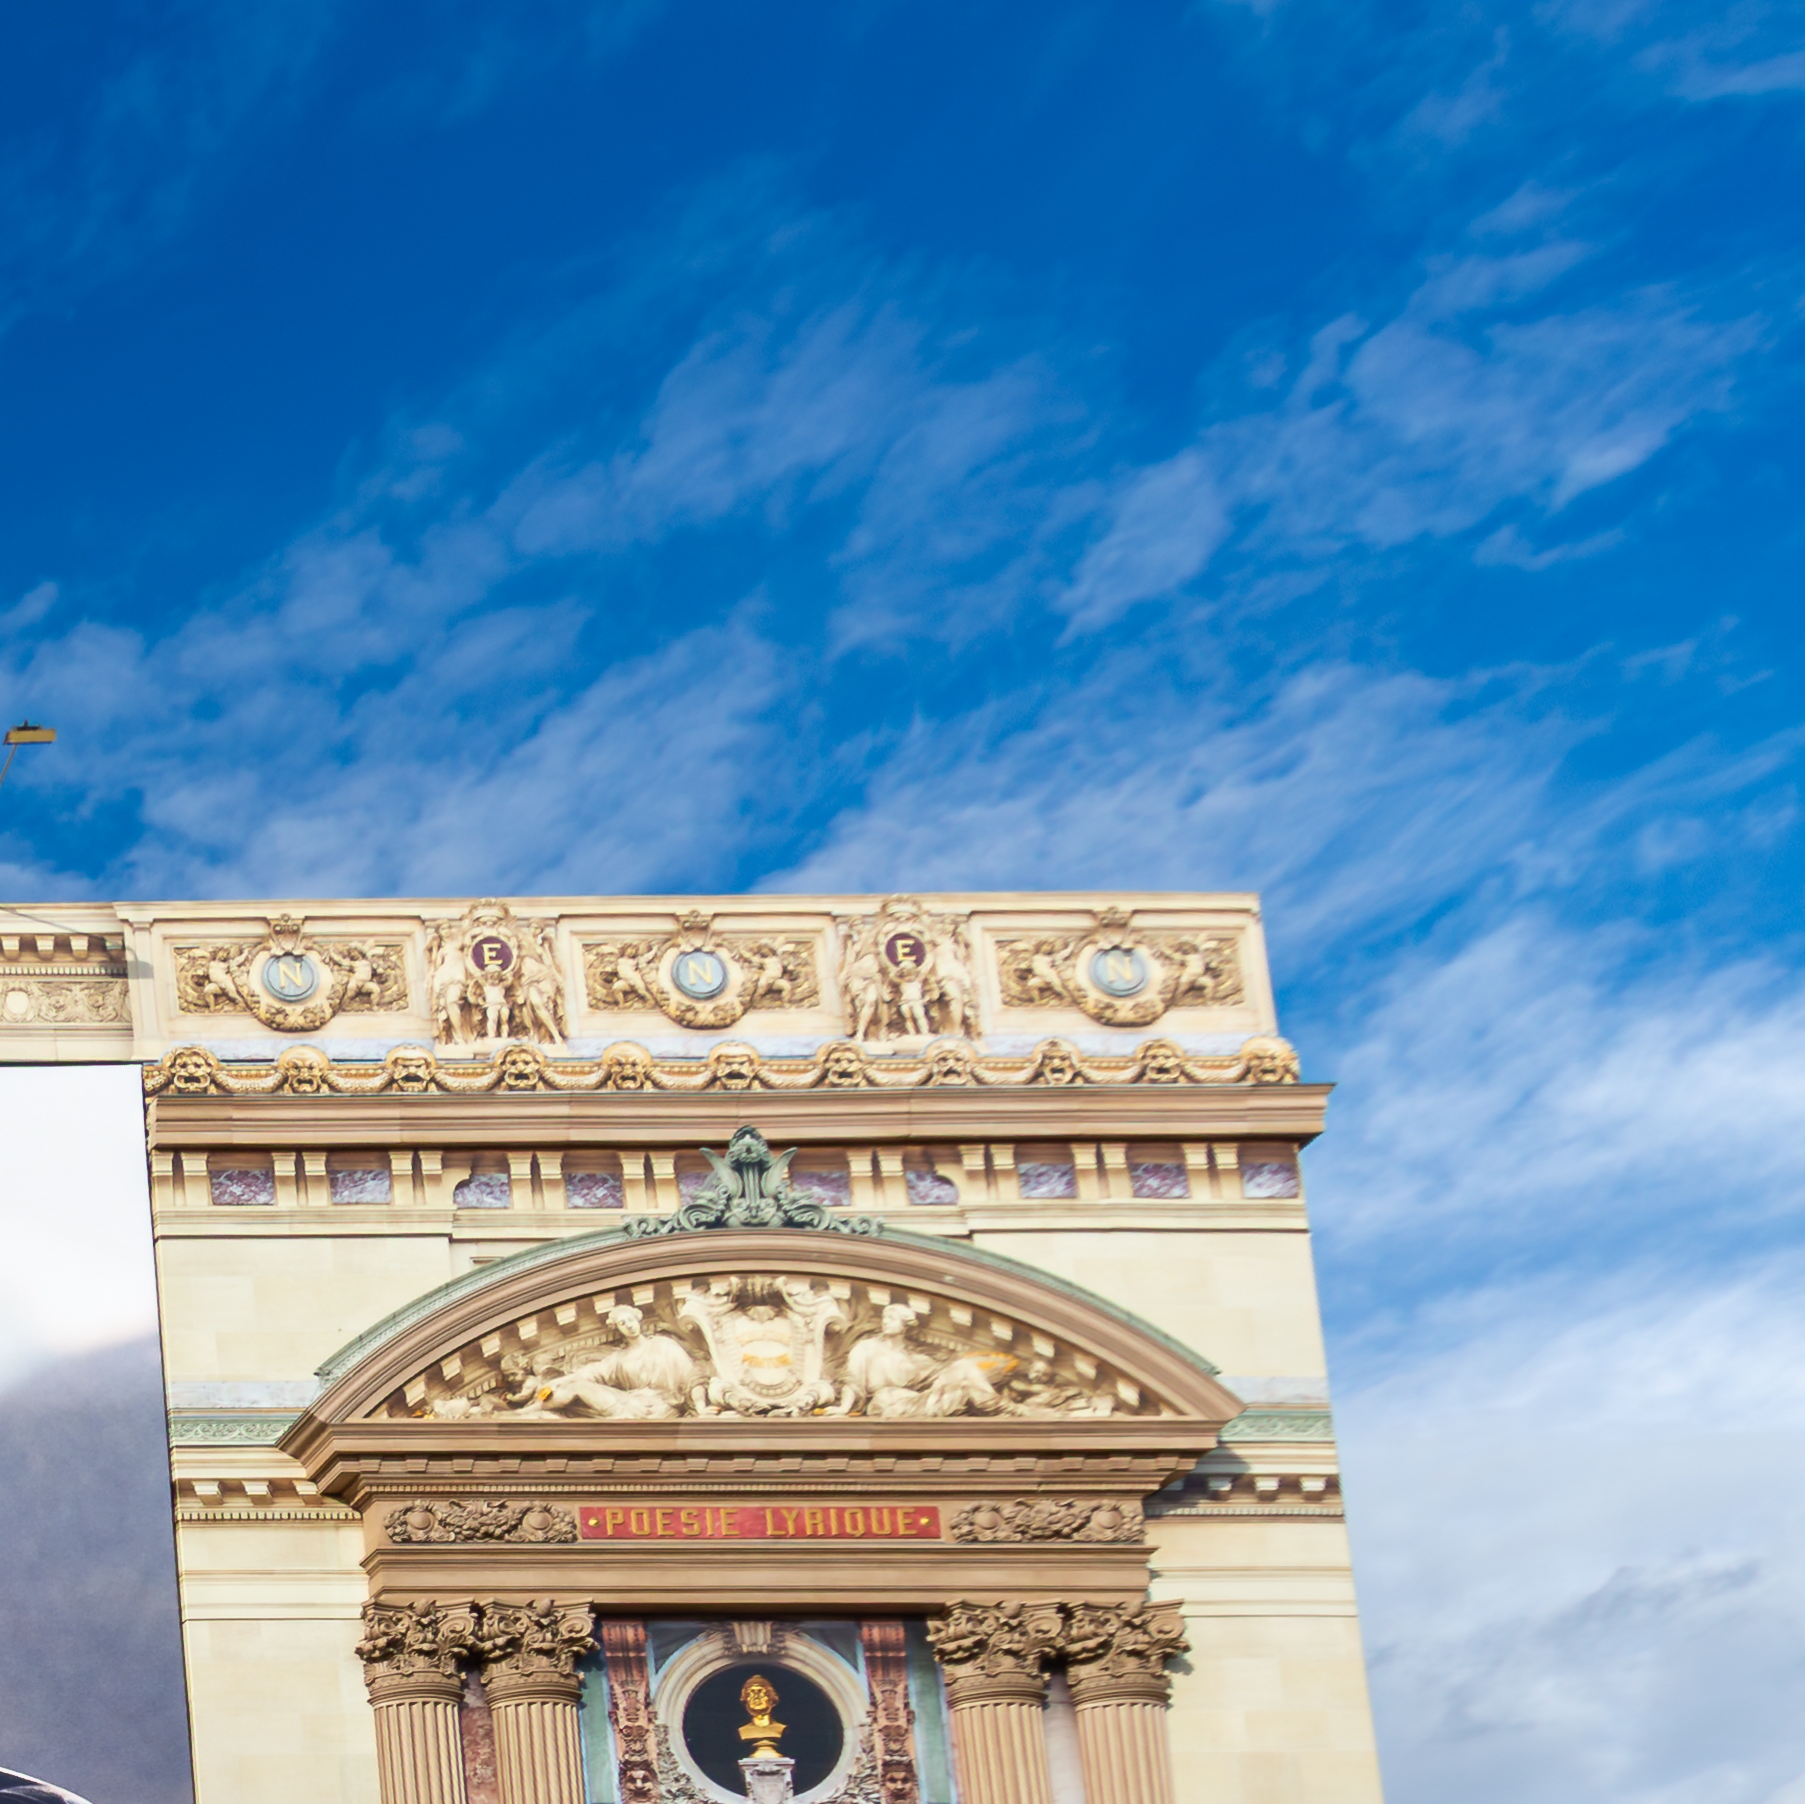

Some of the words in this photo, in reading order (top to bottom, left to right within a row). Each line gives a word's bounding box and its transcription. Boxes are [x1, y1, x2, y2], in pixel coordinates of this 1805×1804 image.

[482, 943, 502, 965] E
[895, 939, 915, 961] E
[279, 962, 302, 988] N
[687, 960, 712, 984] N
[1107, 957, 1132, 983] N
[605, 1507, 741, 1537] POESIE
[765, 1507, 919, 1538] LYRIQUE
